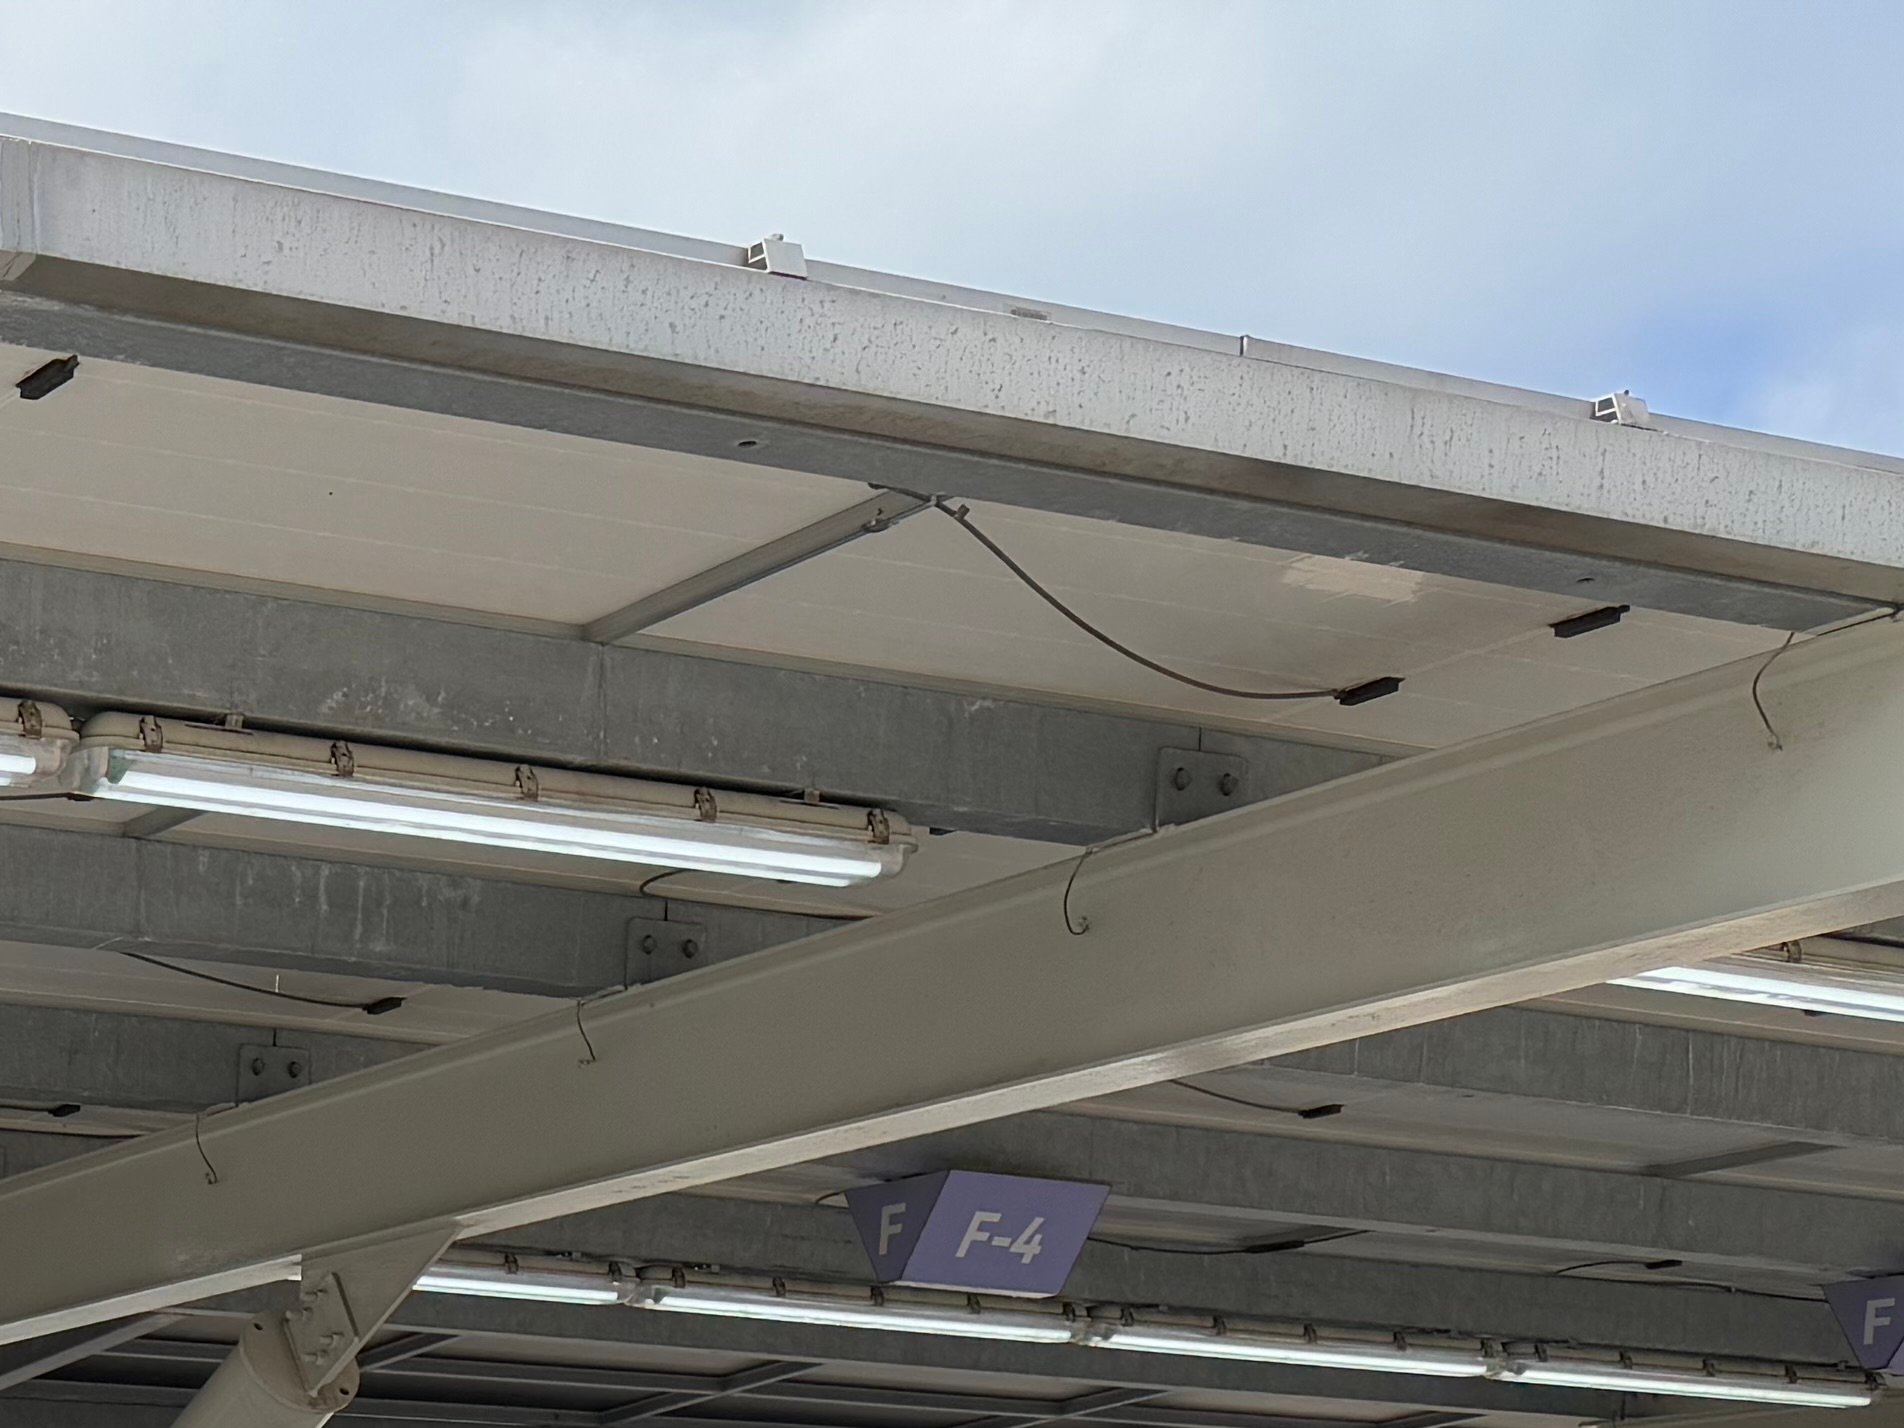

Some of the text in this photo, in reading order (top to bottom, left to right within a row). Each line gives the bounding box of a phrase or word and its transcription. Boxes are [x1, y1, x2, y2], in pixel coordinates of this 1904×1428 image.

[878, 1202, 906, 1256] F
[955, 1211, 1045, 1264] F-4
[1863, 1298, 1896, 1345] F
